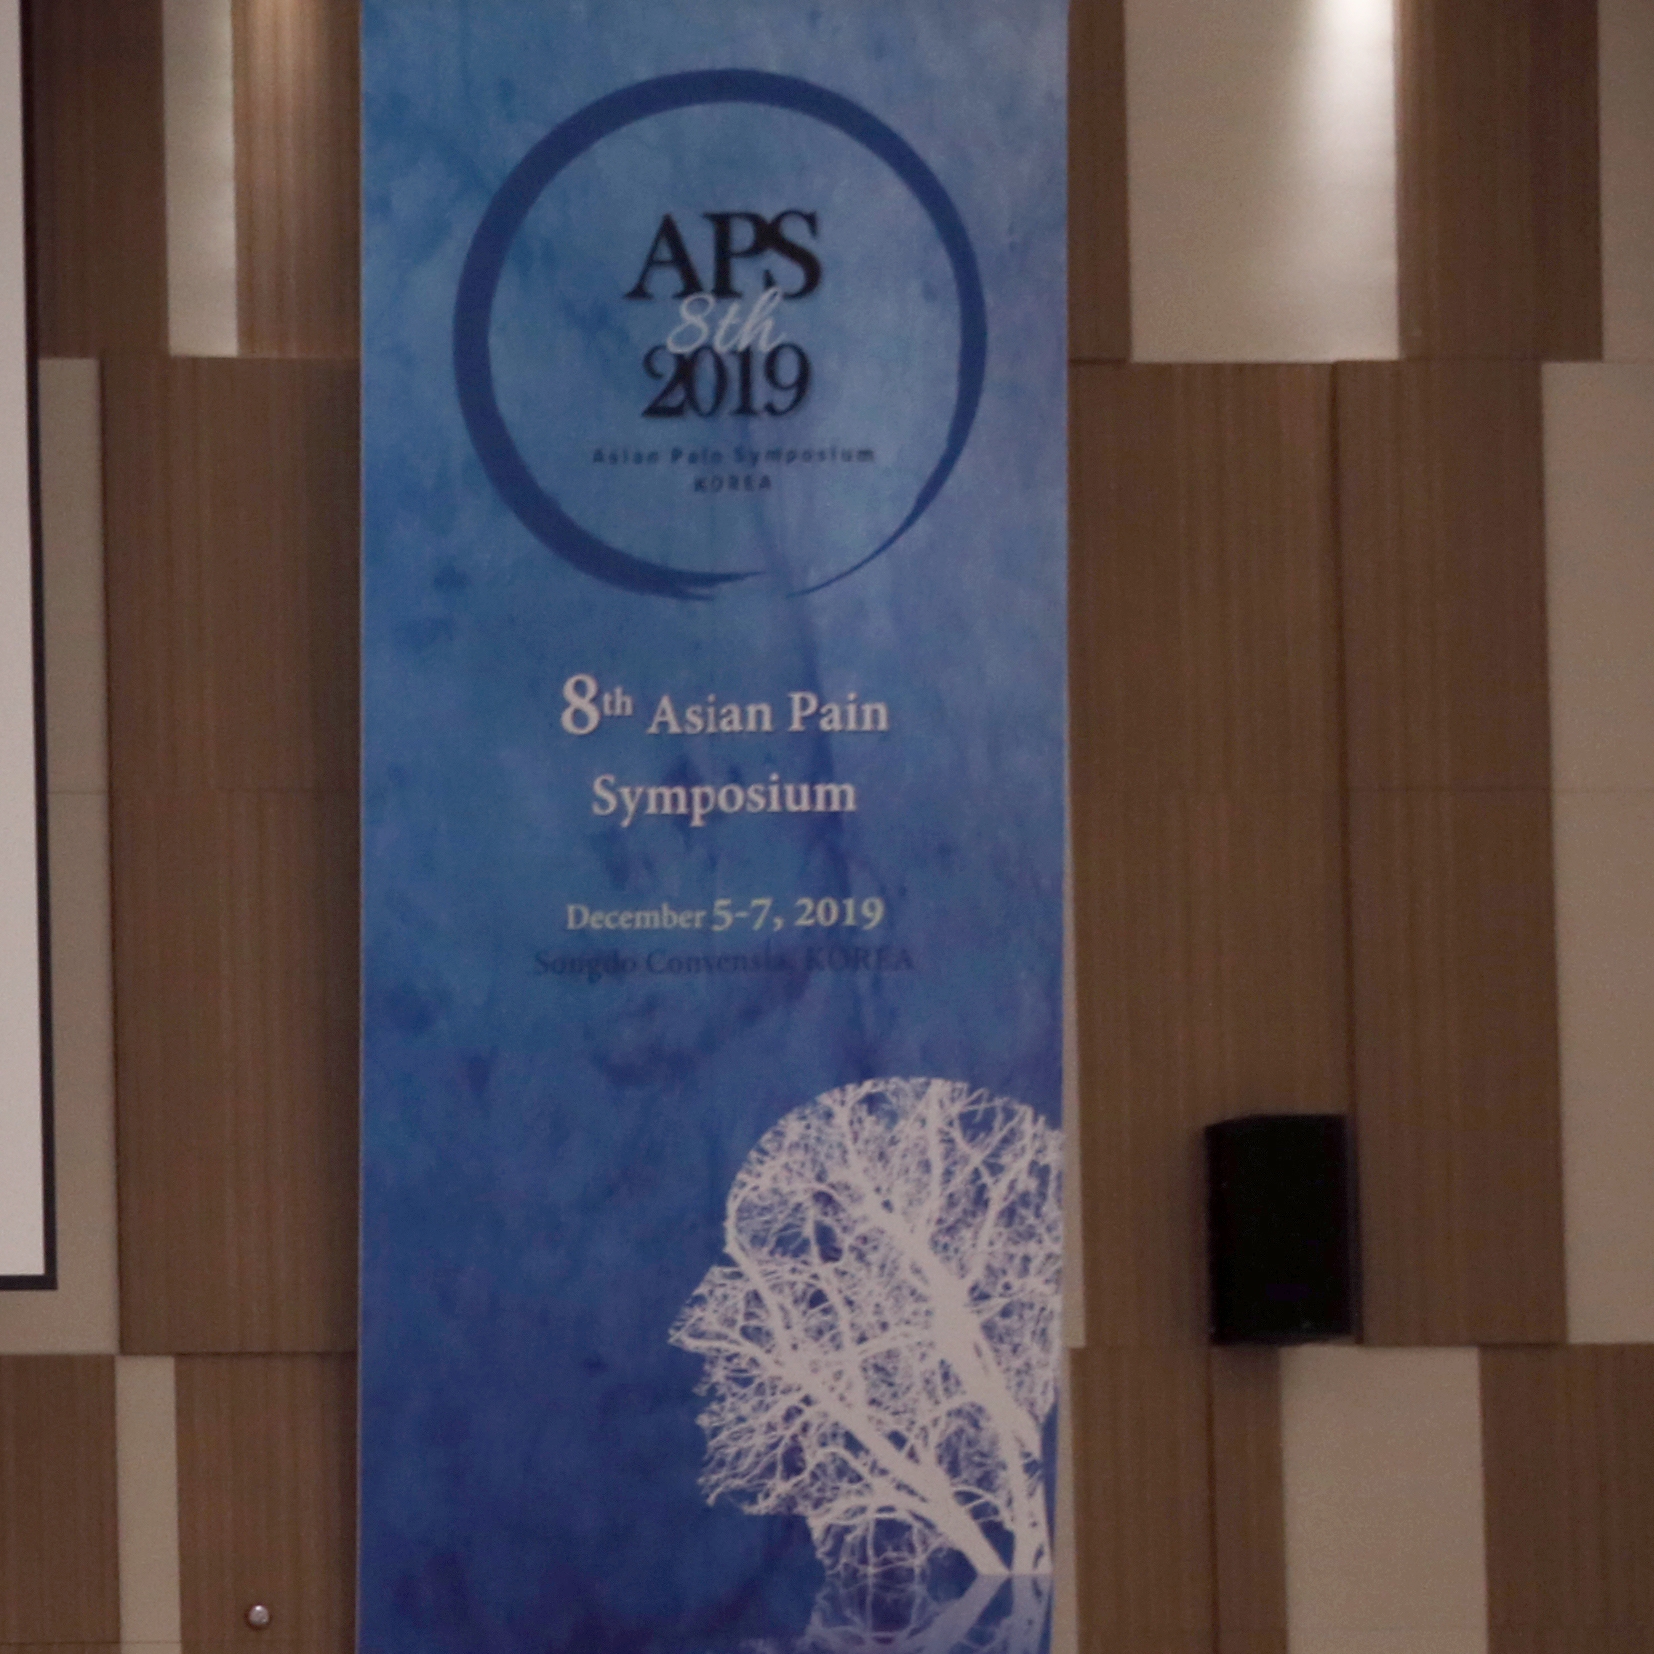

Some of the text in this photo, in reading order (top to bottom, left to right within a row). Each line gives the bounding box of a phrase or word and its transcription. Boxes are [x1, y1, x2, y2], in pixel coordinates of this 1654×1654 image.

[623, 209, 823, 301] APS
[667, 285, 788, 354] 8th
[641, 343, 811, 419] 2019
[592, 445, 875, 468] Asian Pain Symposium
[693, 475, 772, 493] KOREA
[561, 673, 889, 736] 8th Asian Pain
[592, 773, 857, 826] Symposium
[566, 897, 884, 934] December 5-7, 2019
[534, 949, 638, 979] Songdo
[803, 947, 915, 974] KOREA
